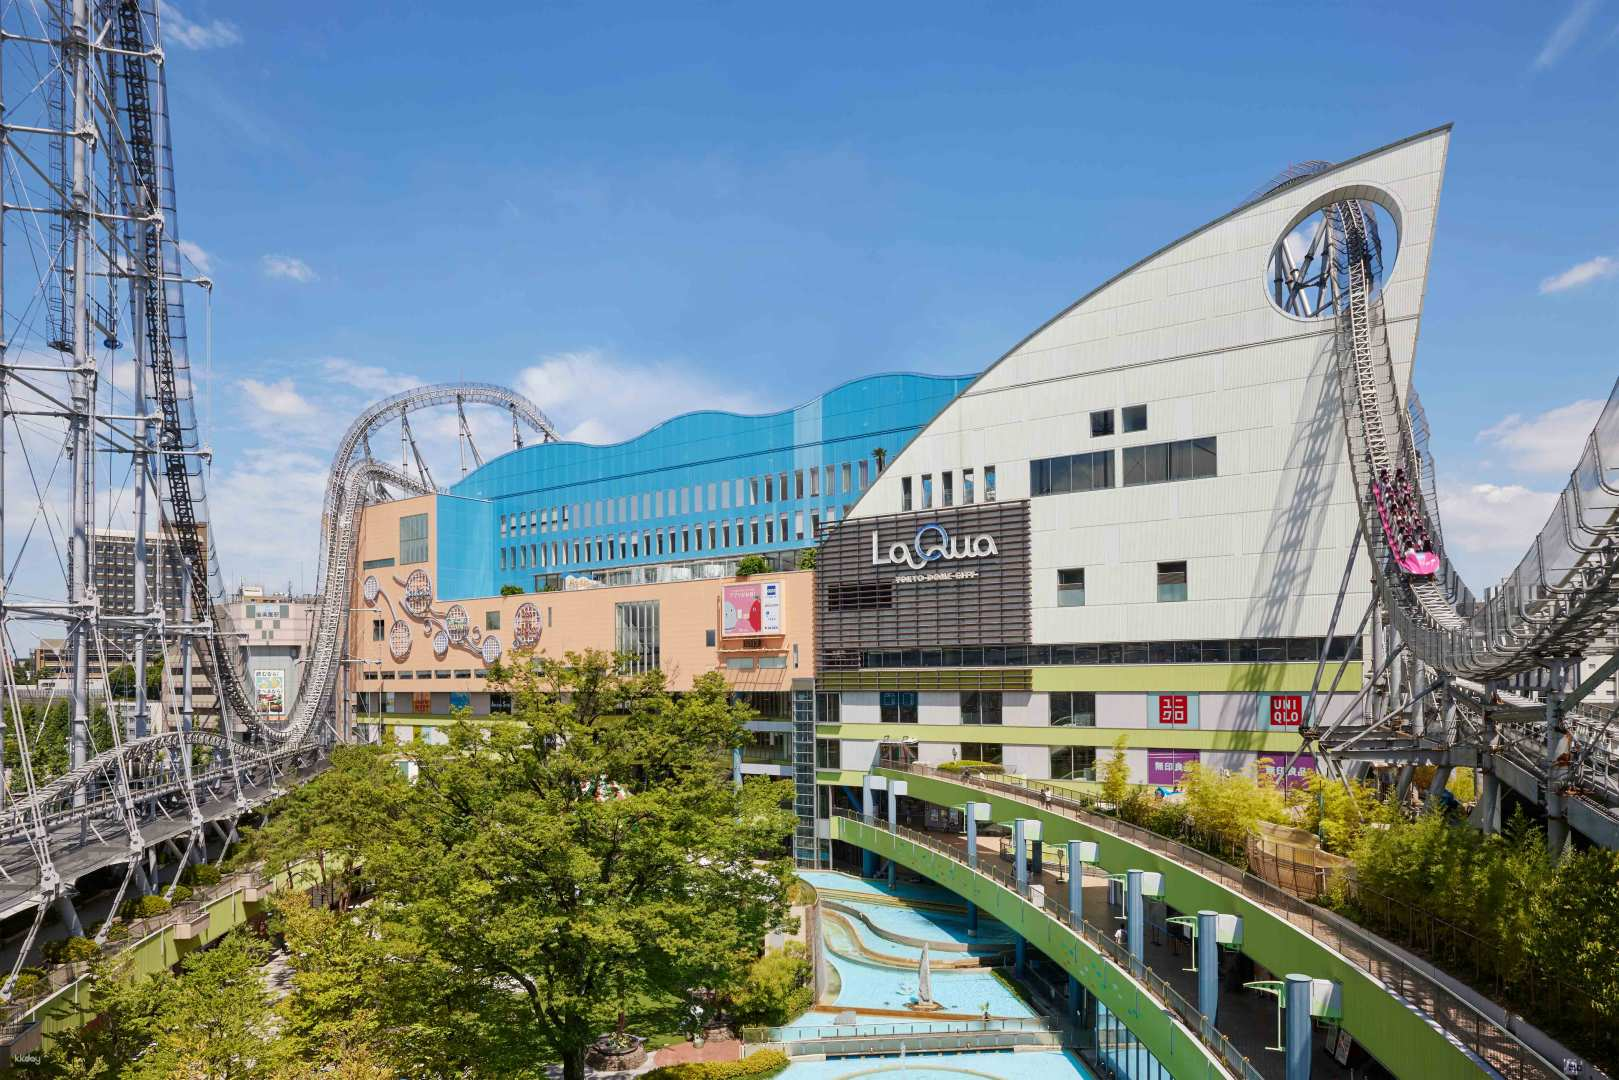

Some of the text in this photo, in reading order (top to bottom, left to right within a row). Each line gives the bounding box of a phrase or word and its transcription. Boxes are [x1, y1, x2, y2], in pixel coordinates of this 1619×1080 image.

[872, 523, 999, 570] LaQua
[1162, 698, 1185, 709] ユニ
[1273, 699, 1297, 710] UNI
[1162, 710, 1185, 721] クロ
[1273, 711, 1299, 724] QLO
[1155, 761, 1191, 772] 無印良
